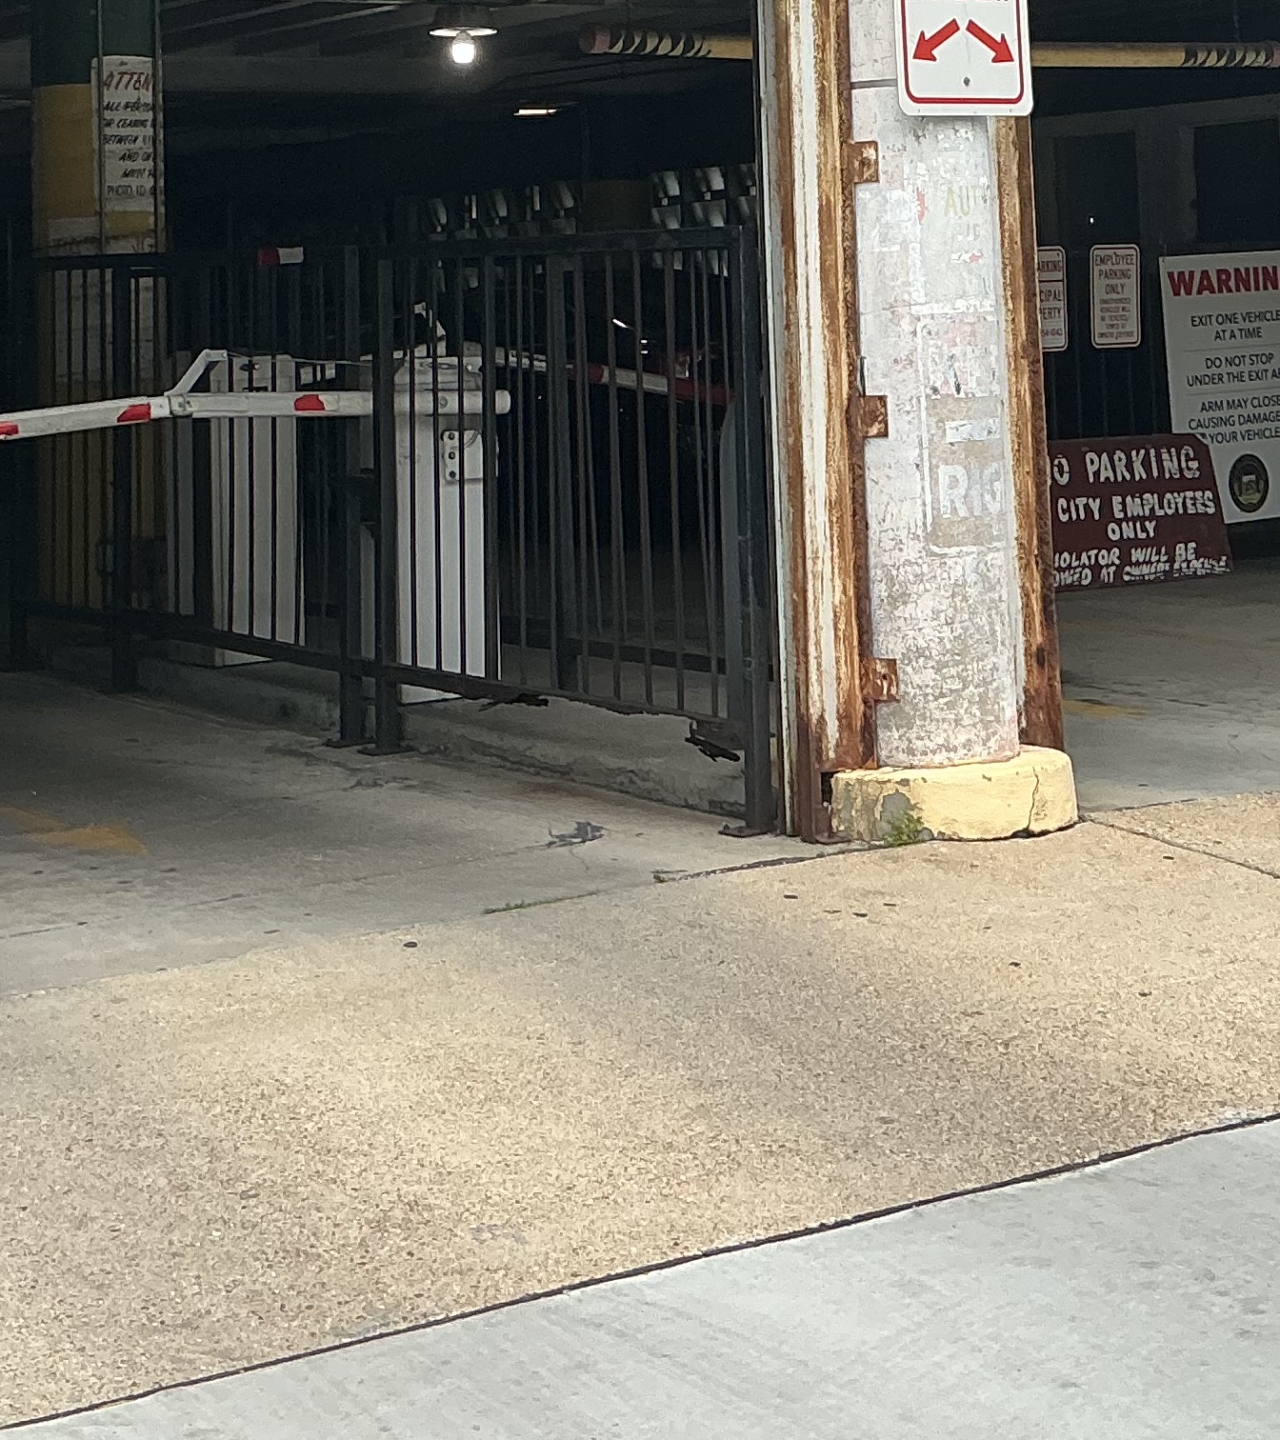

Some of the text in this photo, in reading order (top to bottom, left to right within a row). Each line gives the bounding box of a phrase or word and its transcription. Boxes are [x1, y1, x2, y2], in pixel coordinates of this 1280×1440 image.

[1095, 253, 1135, 266] EMPLOYEE
[1190, 314, 1214, 327] EXIT
[1215, 312, 1239, 326] ONE
[1214, 326, 1262, 341] AT A TIME
[1205, 353, 1274, 369] DO NOT STOP
[1187, 373, 1224, 387] UNDER
[1227, 371, 1245, 385] THE
[1248, 369, 1269, 382] EXIT
[1200, 400, 1224, 414] ARM
[1226, 397, 1250, 410] MAY
[1188, 415, 1236, 431] CAUSING
[1208, 426, 1280, 445] YOUR VEHICLE
[1084, 445, 1200, 484] PARKING
[1057, 489, 1217, 522] CITY EMPLOYEES
[1107, 520, 1157, 541] ONLY
[1130, 545, 1169, 564] WILL
[1174, 541, 1197, 561] BE
[1100, 565, 1117, 584] AT
